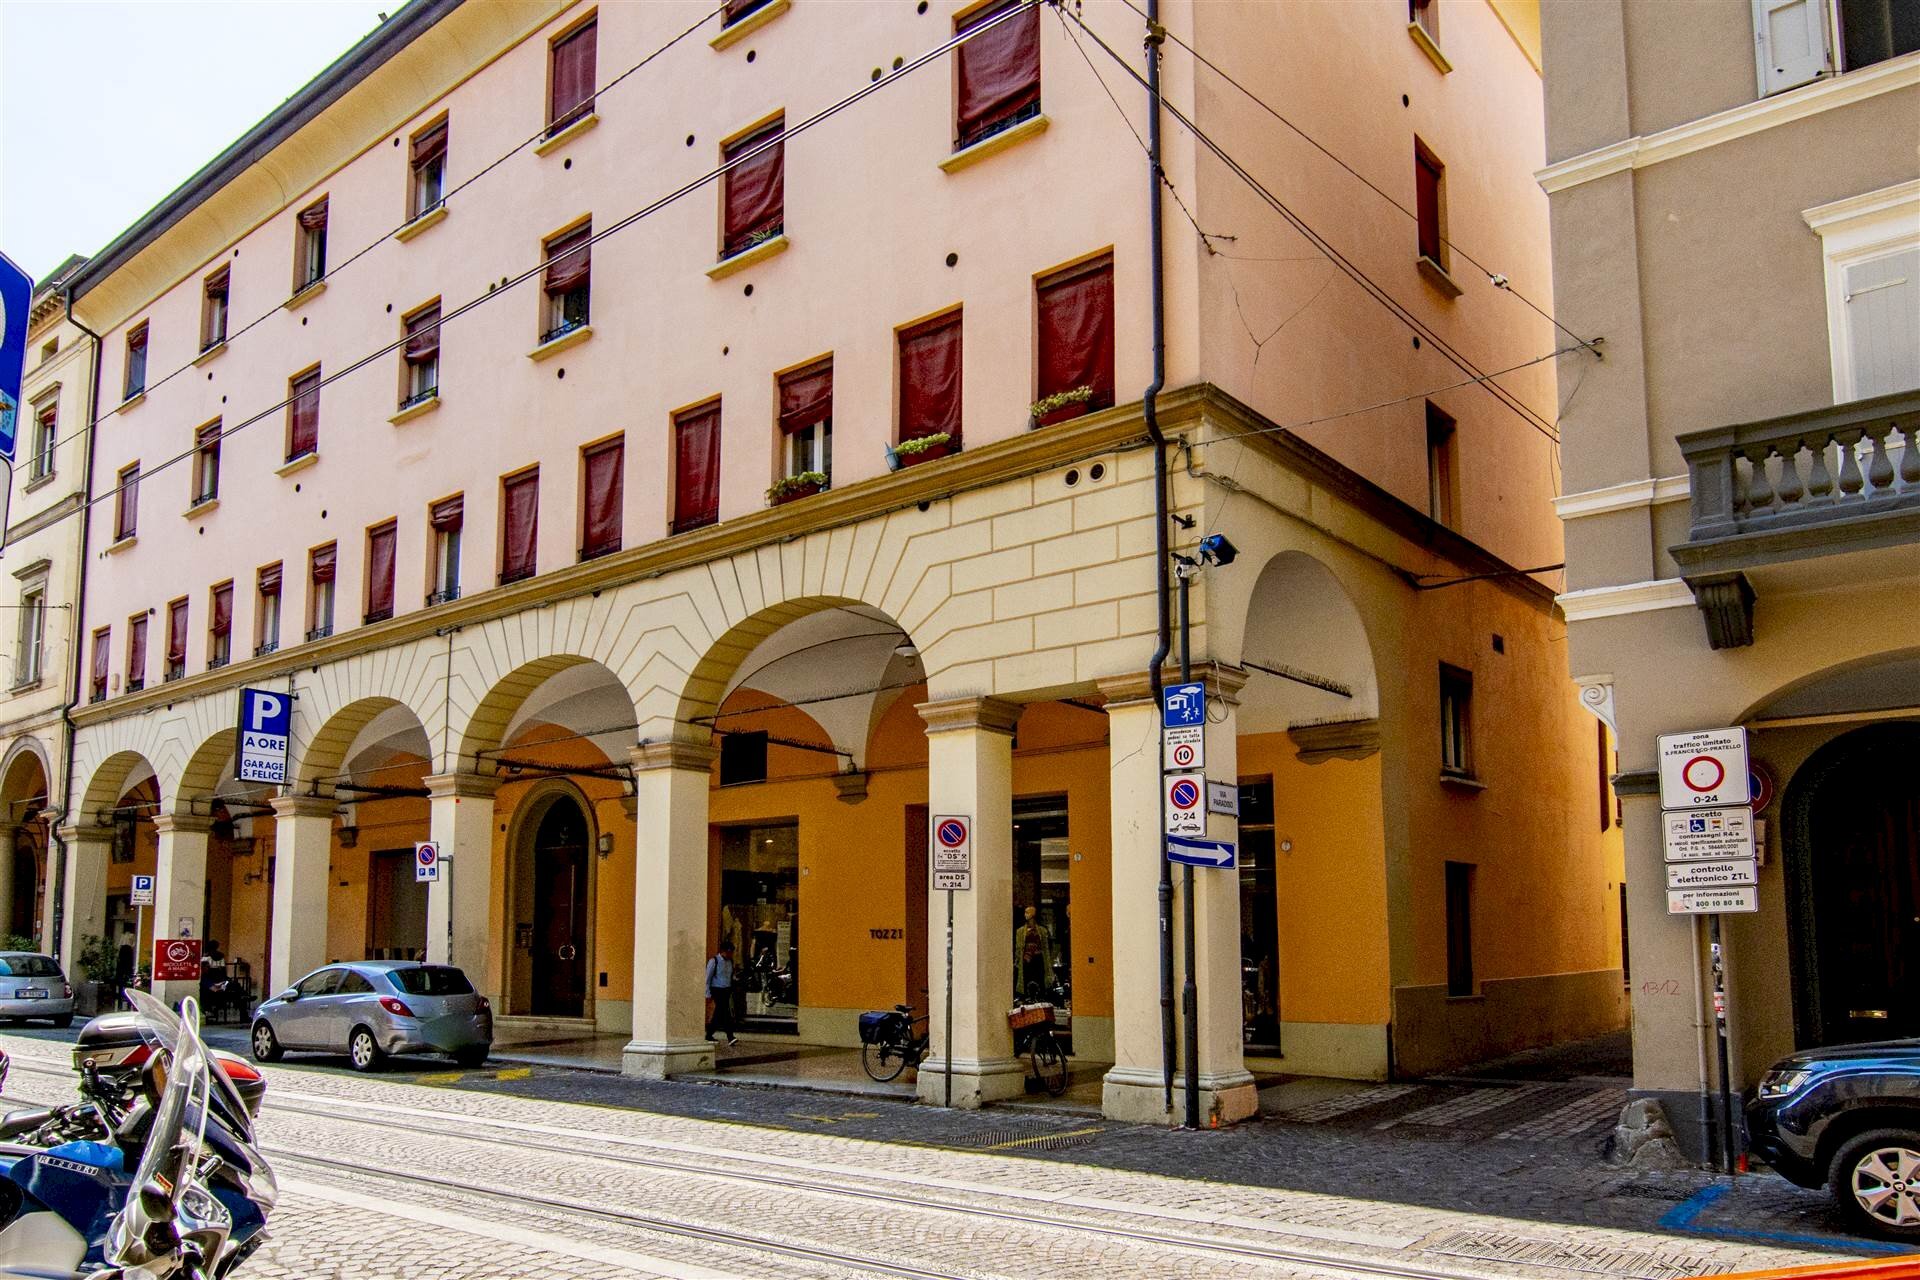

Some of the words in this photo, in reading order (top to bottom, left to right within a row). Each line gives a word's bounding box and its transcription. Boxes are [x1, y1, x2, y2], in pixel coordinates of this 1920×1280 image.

[253, 693, 281, 730] P
[245, 737, 255, 747] A
[258, 738, 285, 750] ORE
[1179, 750, 1189, 760] 10
[244, 760, 284, 770] GARAGE
[1693, 795, 1718, 803] 0-24
[1691, 865, 1733, 874] controllo
[139, 878, 148, 888] P
[1677, 875, 1728, 884] elettronico
[869, 929, 902, 939] TOZZI
